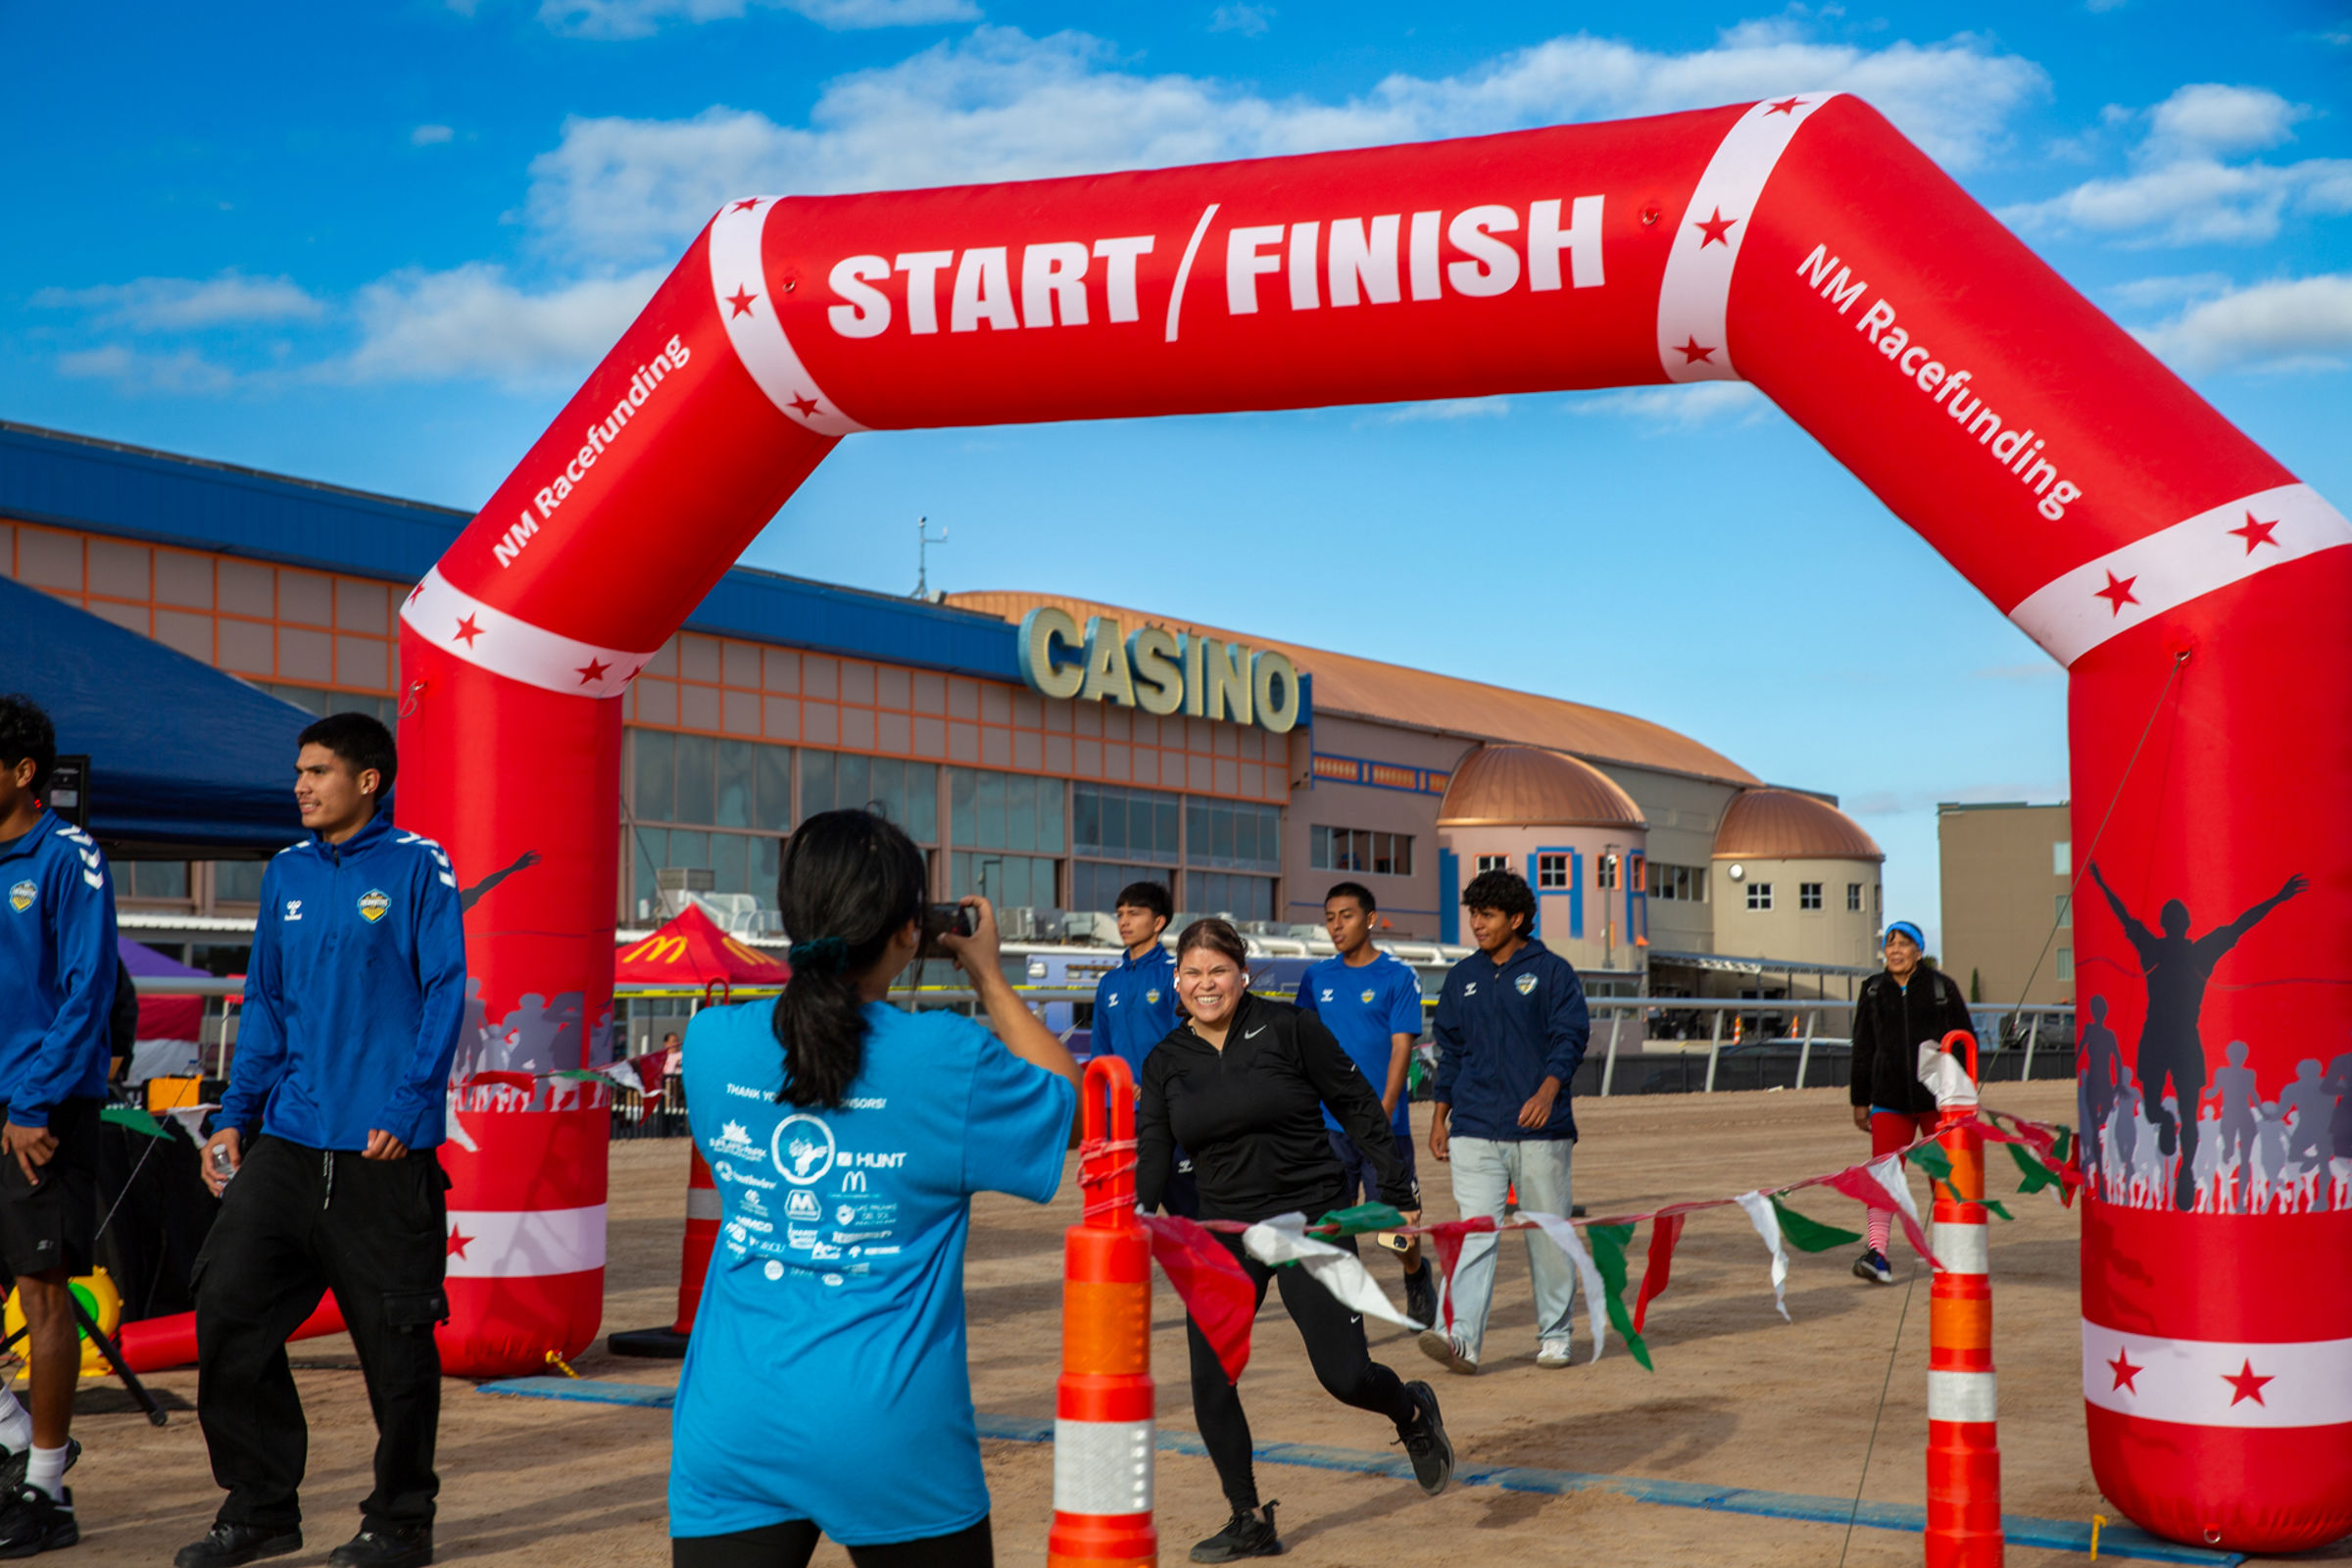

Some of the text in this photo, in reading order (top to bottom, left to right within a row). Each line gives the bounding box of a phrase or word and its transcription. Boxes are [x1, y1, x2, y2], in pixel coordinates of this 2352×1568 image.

[1795, 242, 2083, 521] NM Racefunding
[492, 333, 691, 568] NM Racefunding
[1017, 606, 1299, 734] CASINO
[726, 1083, 760, 1100] THANK
[856, 1152, 907, 1168] HUNT
